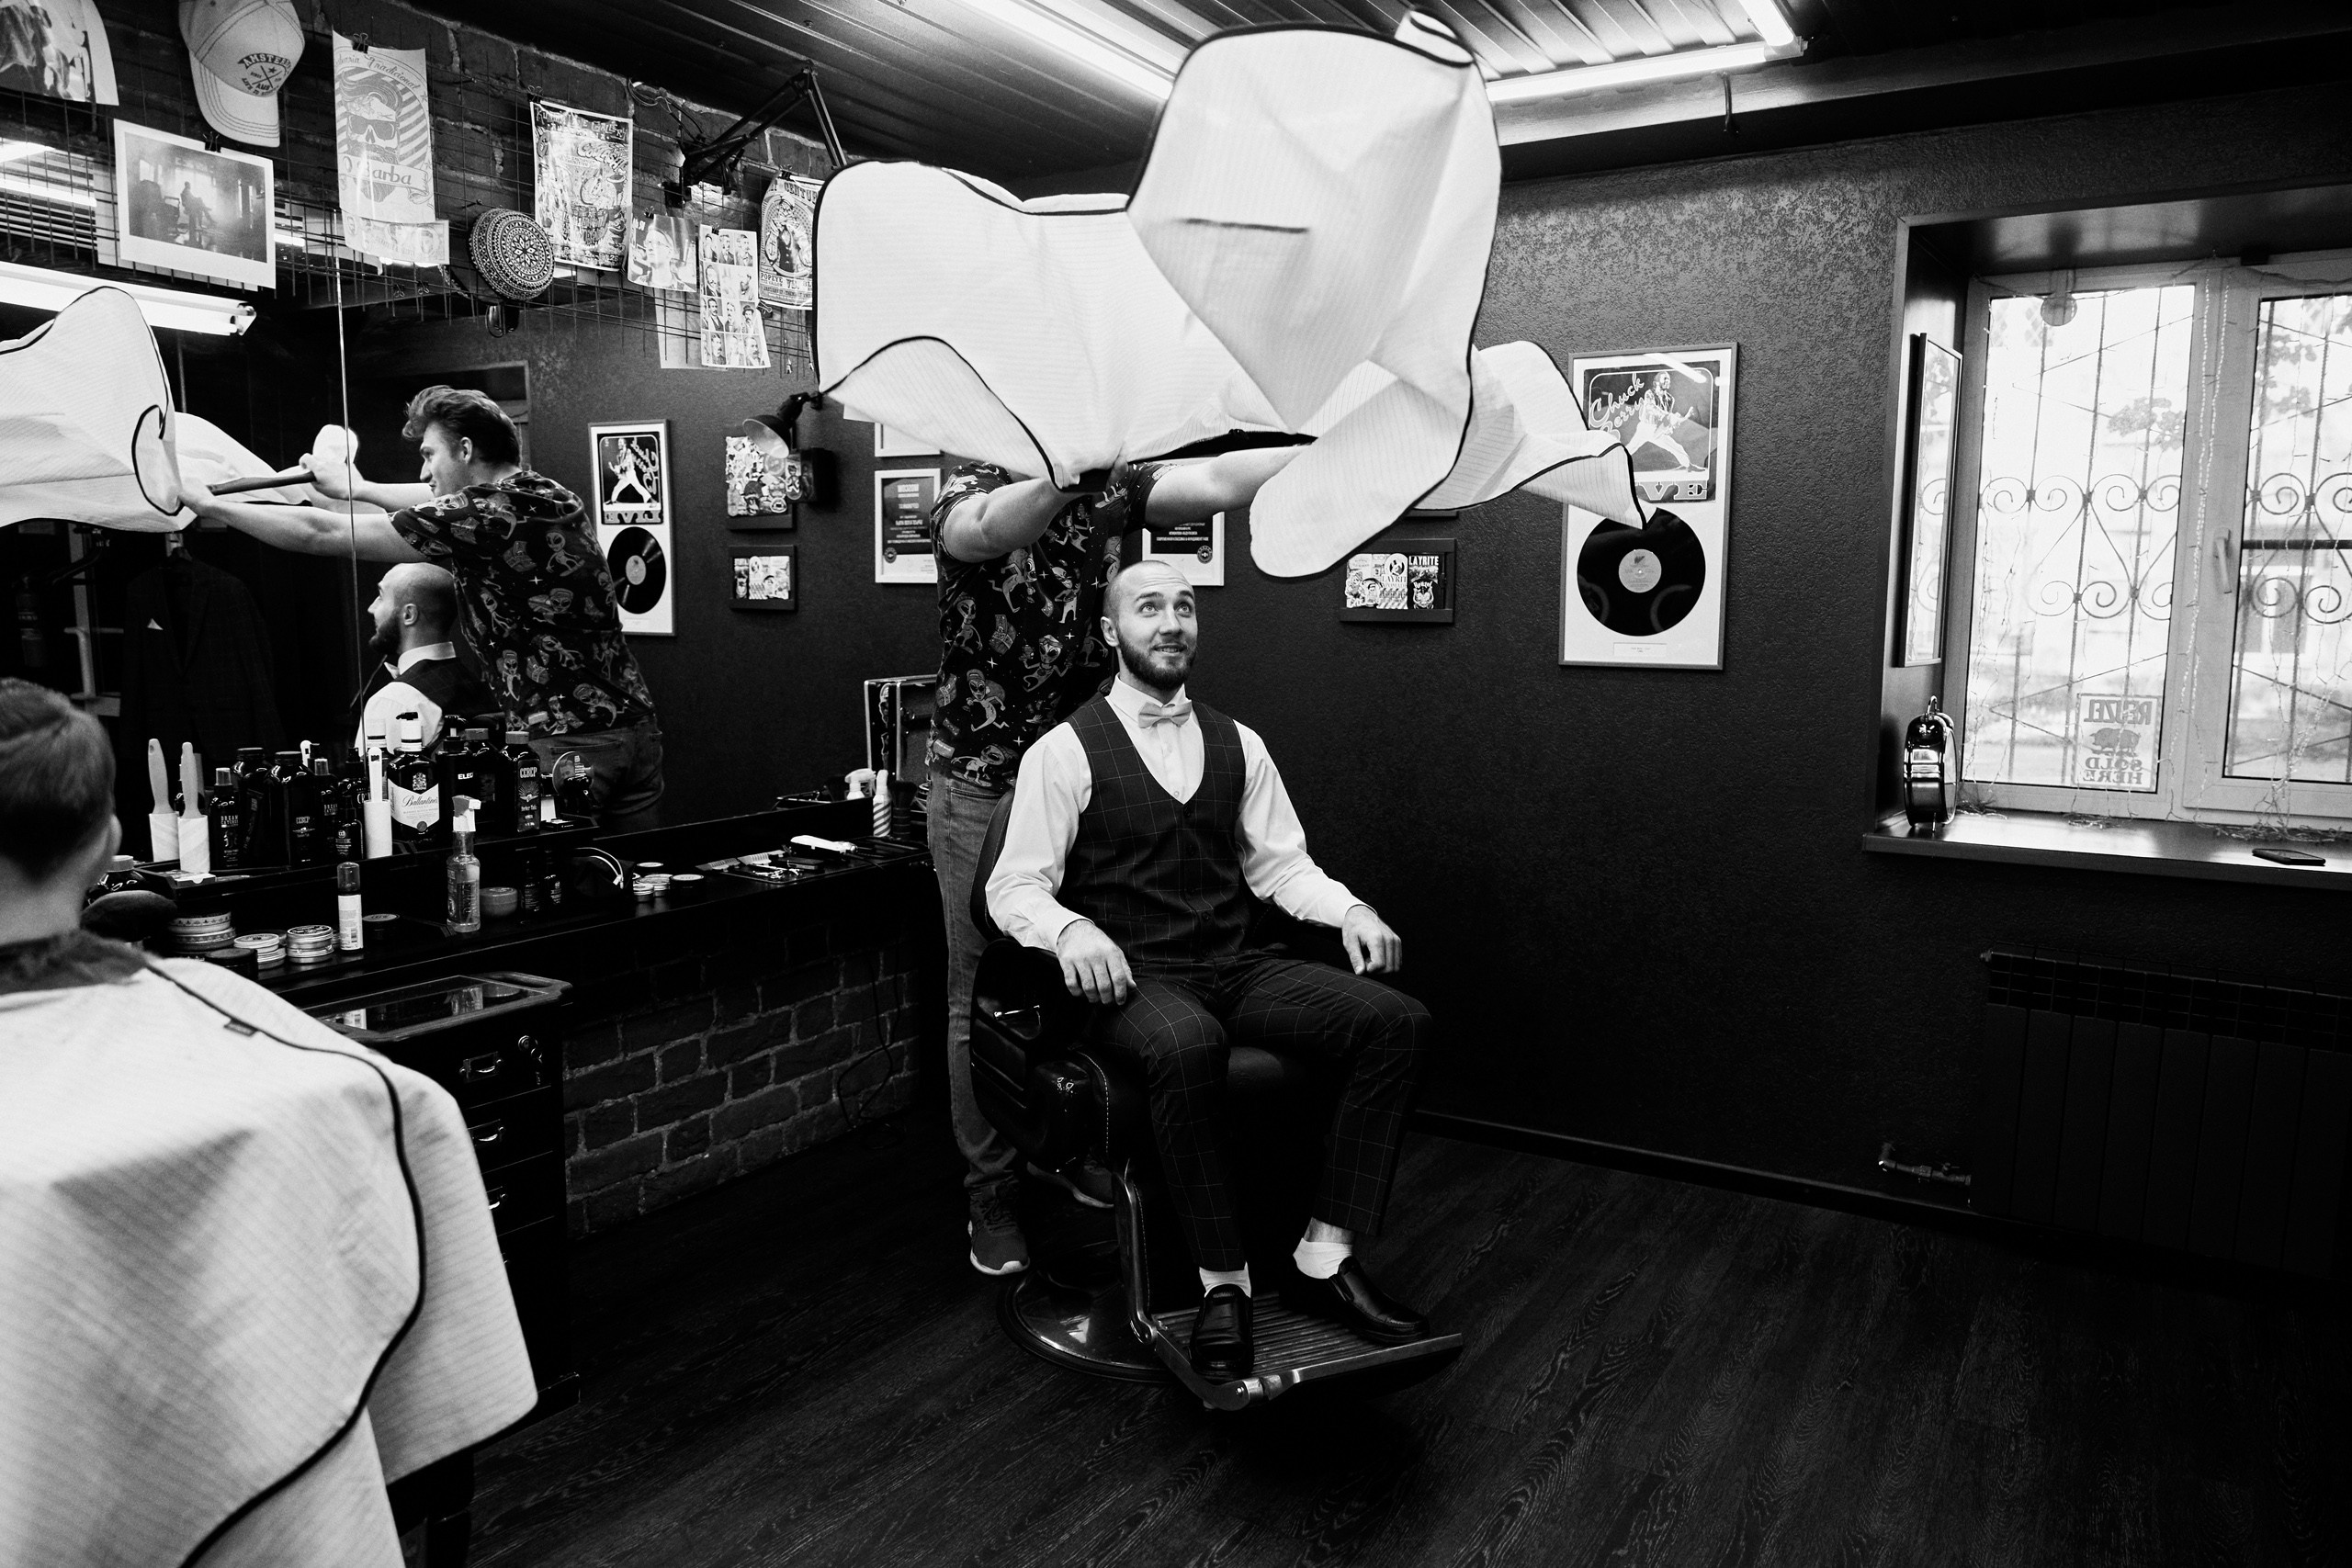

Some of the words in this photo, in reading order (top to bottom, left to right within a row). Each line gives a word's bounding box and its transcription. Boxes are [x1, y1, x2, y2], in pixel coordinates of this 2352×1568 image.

[365, 55, 421, 90] Tradicional
[1589, 372, 1645, 428] Chuck
[1634, 480, 1708, 501] VE
[1408, 555, 1440, 567] LAYRITE
